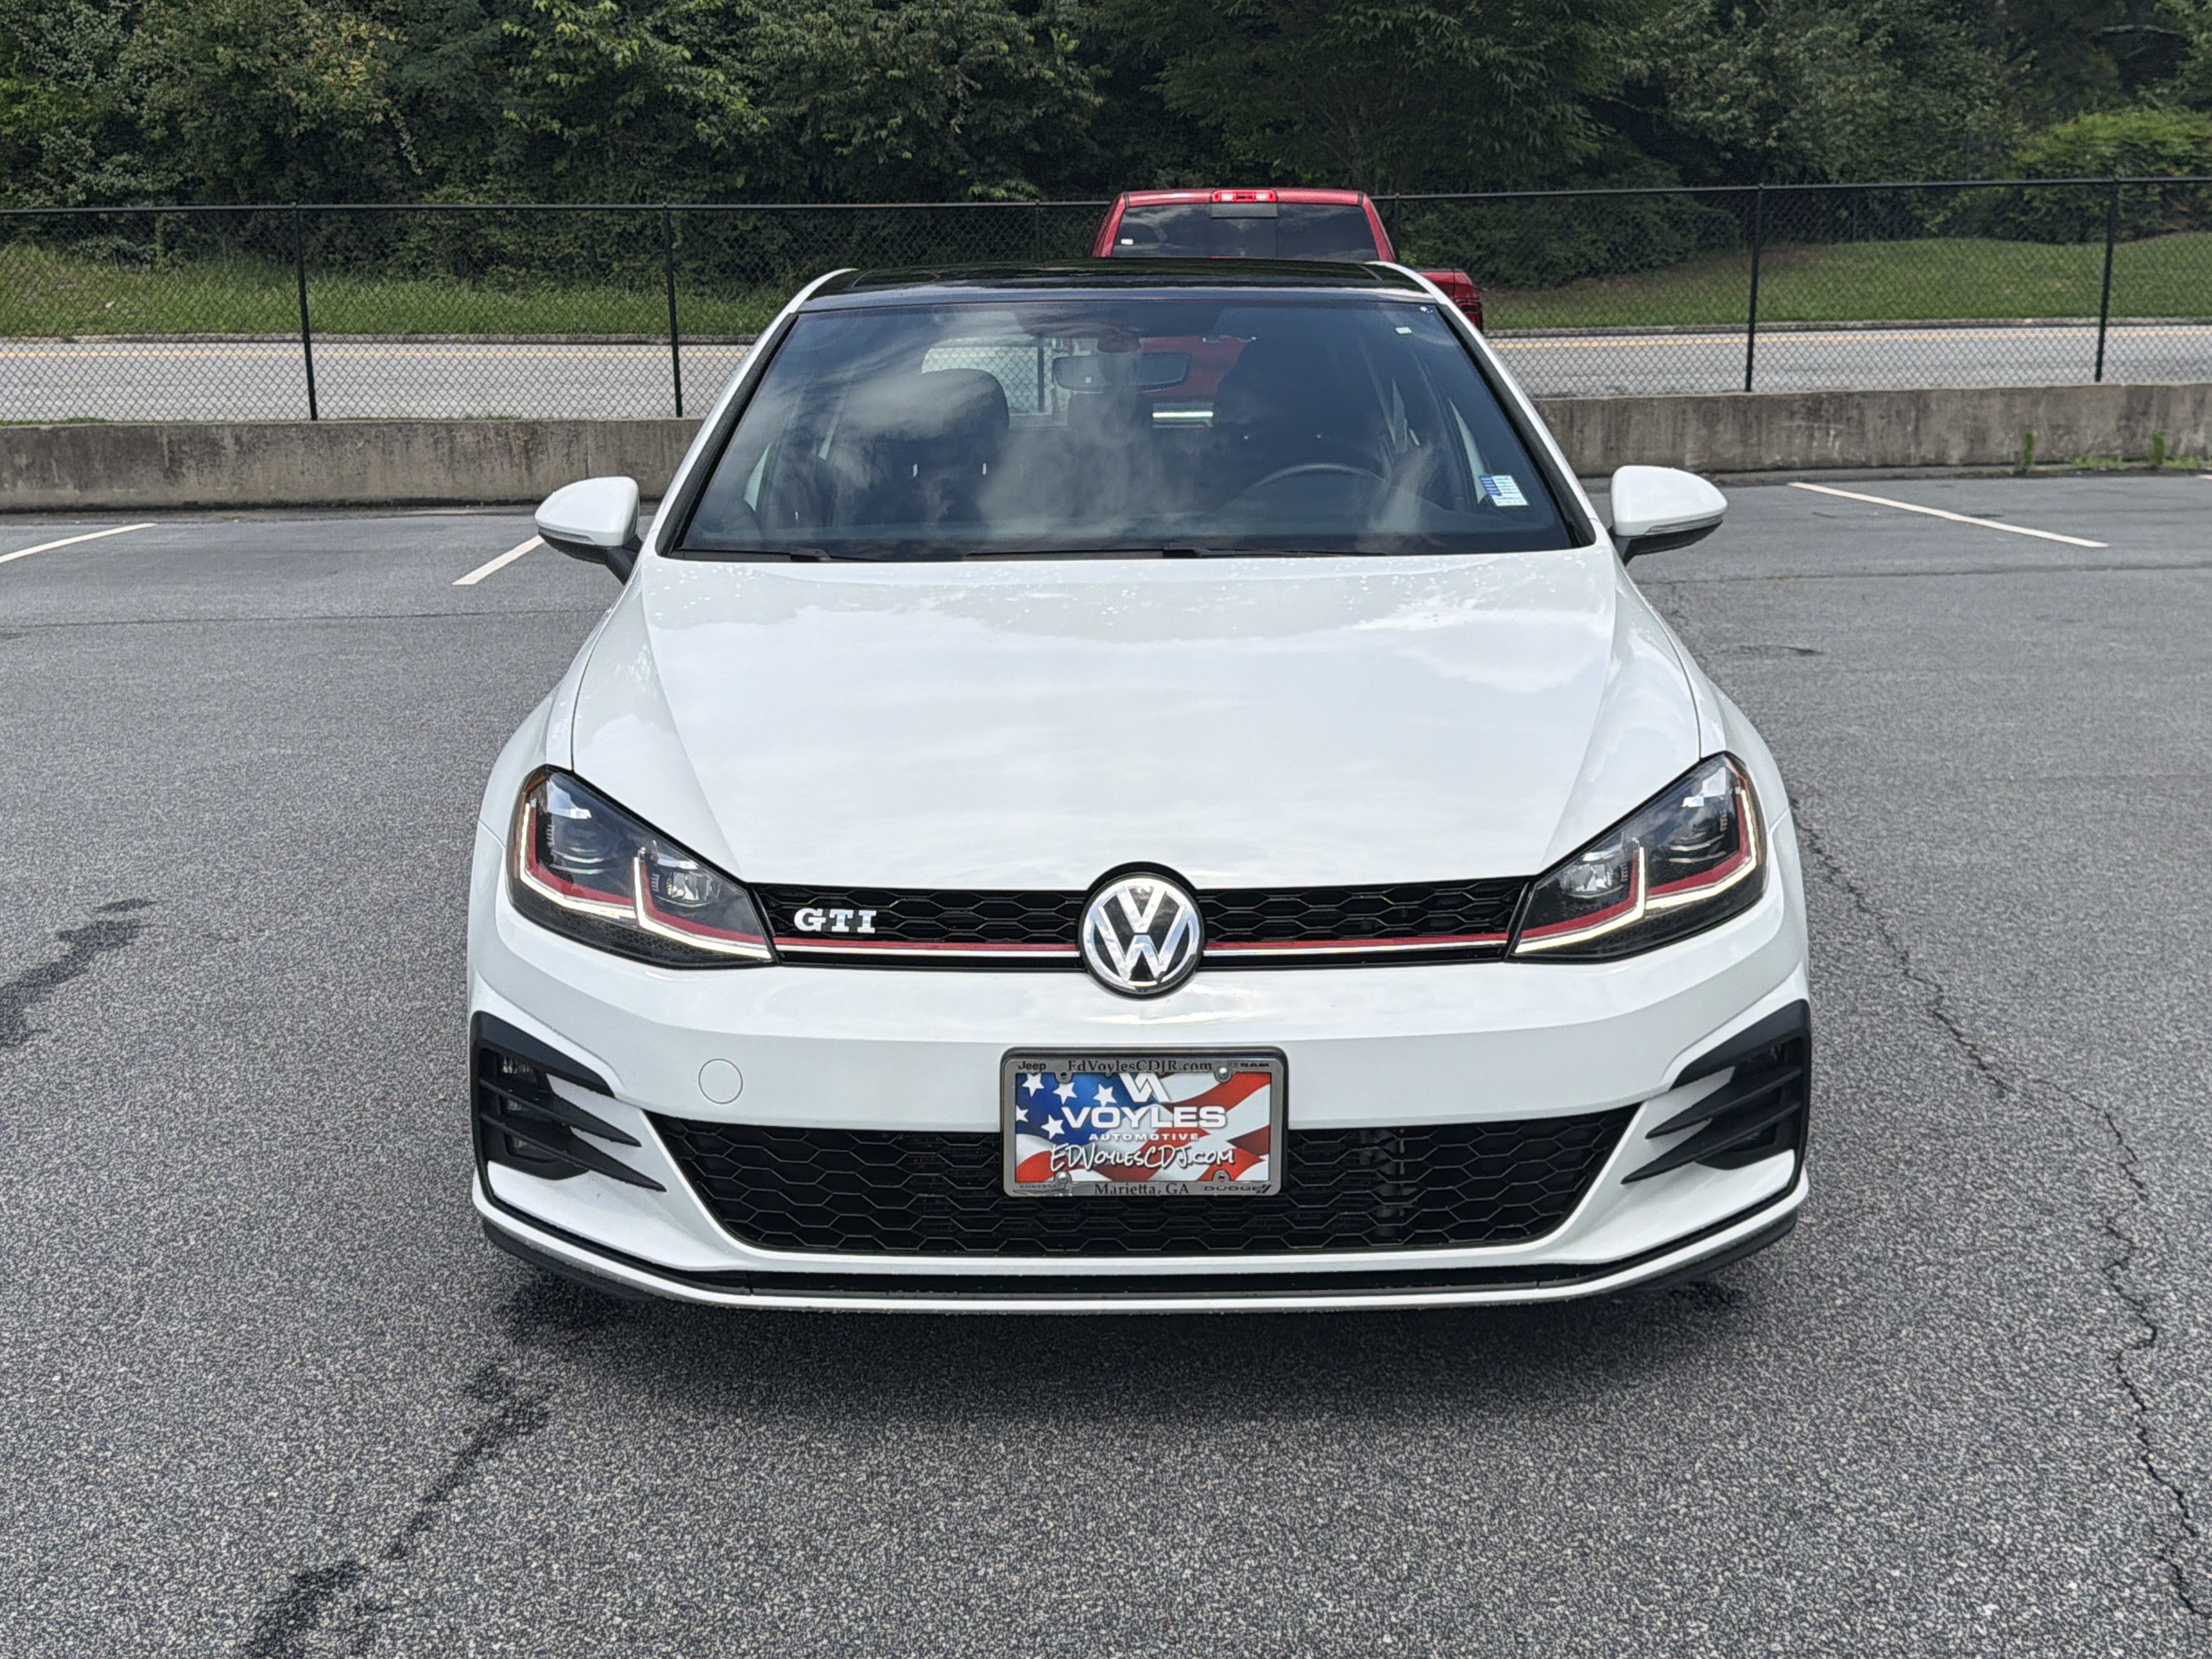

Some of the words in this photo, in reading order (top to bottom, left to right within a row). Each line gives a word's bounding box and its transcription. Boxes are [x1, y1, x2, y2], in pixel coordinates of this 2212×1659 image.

[794, 907, 877, 934] GTI
[1018, 1060, 1047, 1072] Jeep
[1068, 1060, 1212, 1074] EdVoylesCDJR.com
[1061, 1106, 1227, 1128] VOYLES
[1088, 1133, 1200, 1142] AUTOMOTIVE
[1094, 1182, 1161, 1195] Marietta,
[1165, 1183, 1190, 1194] GA
